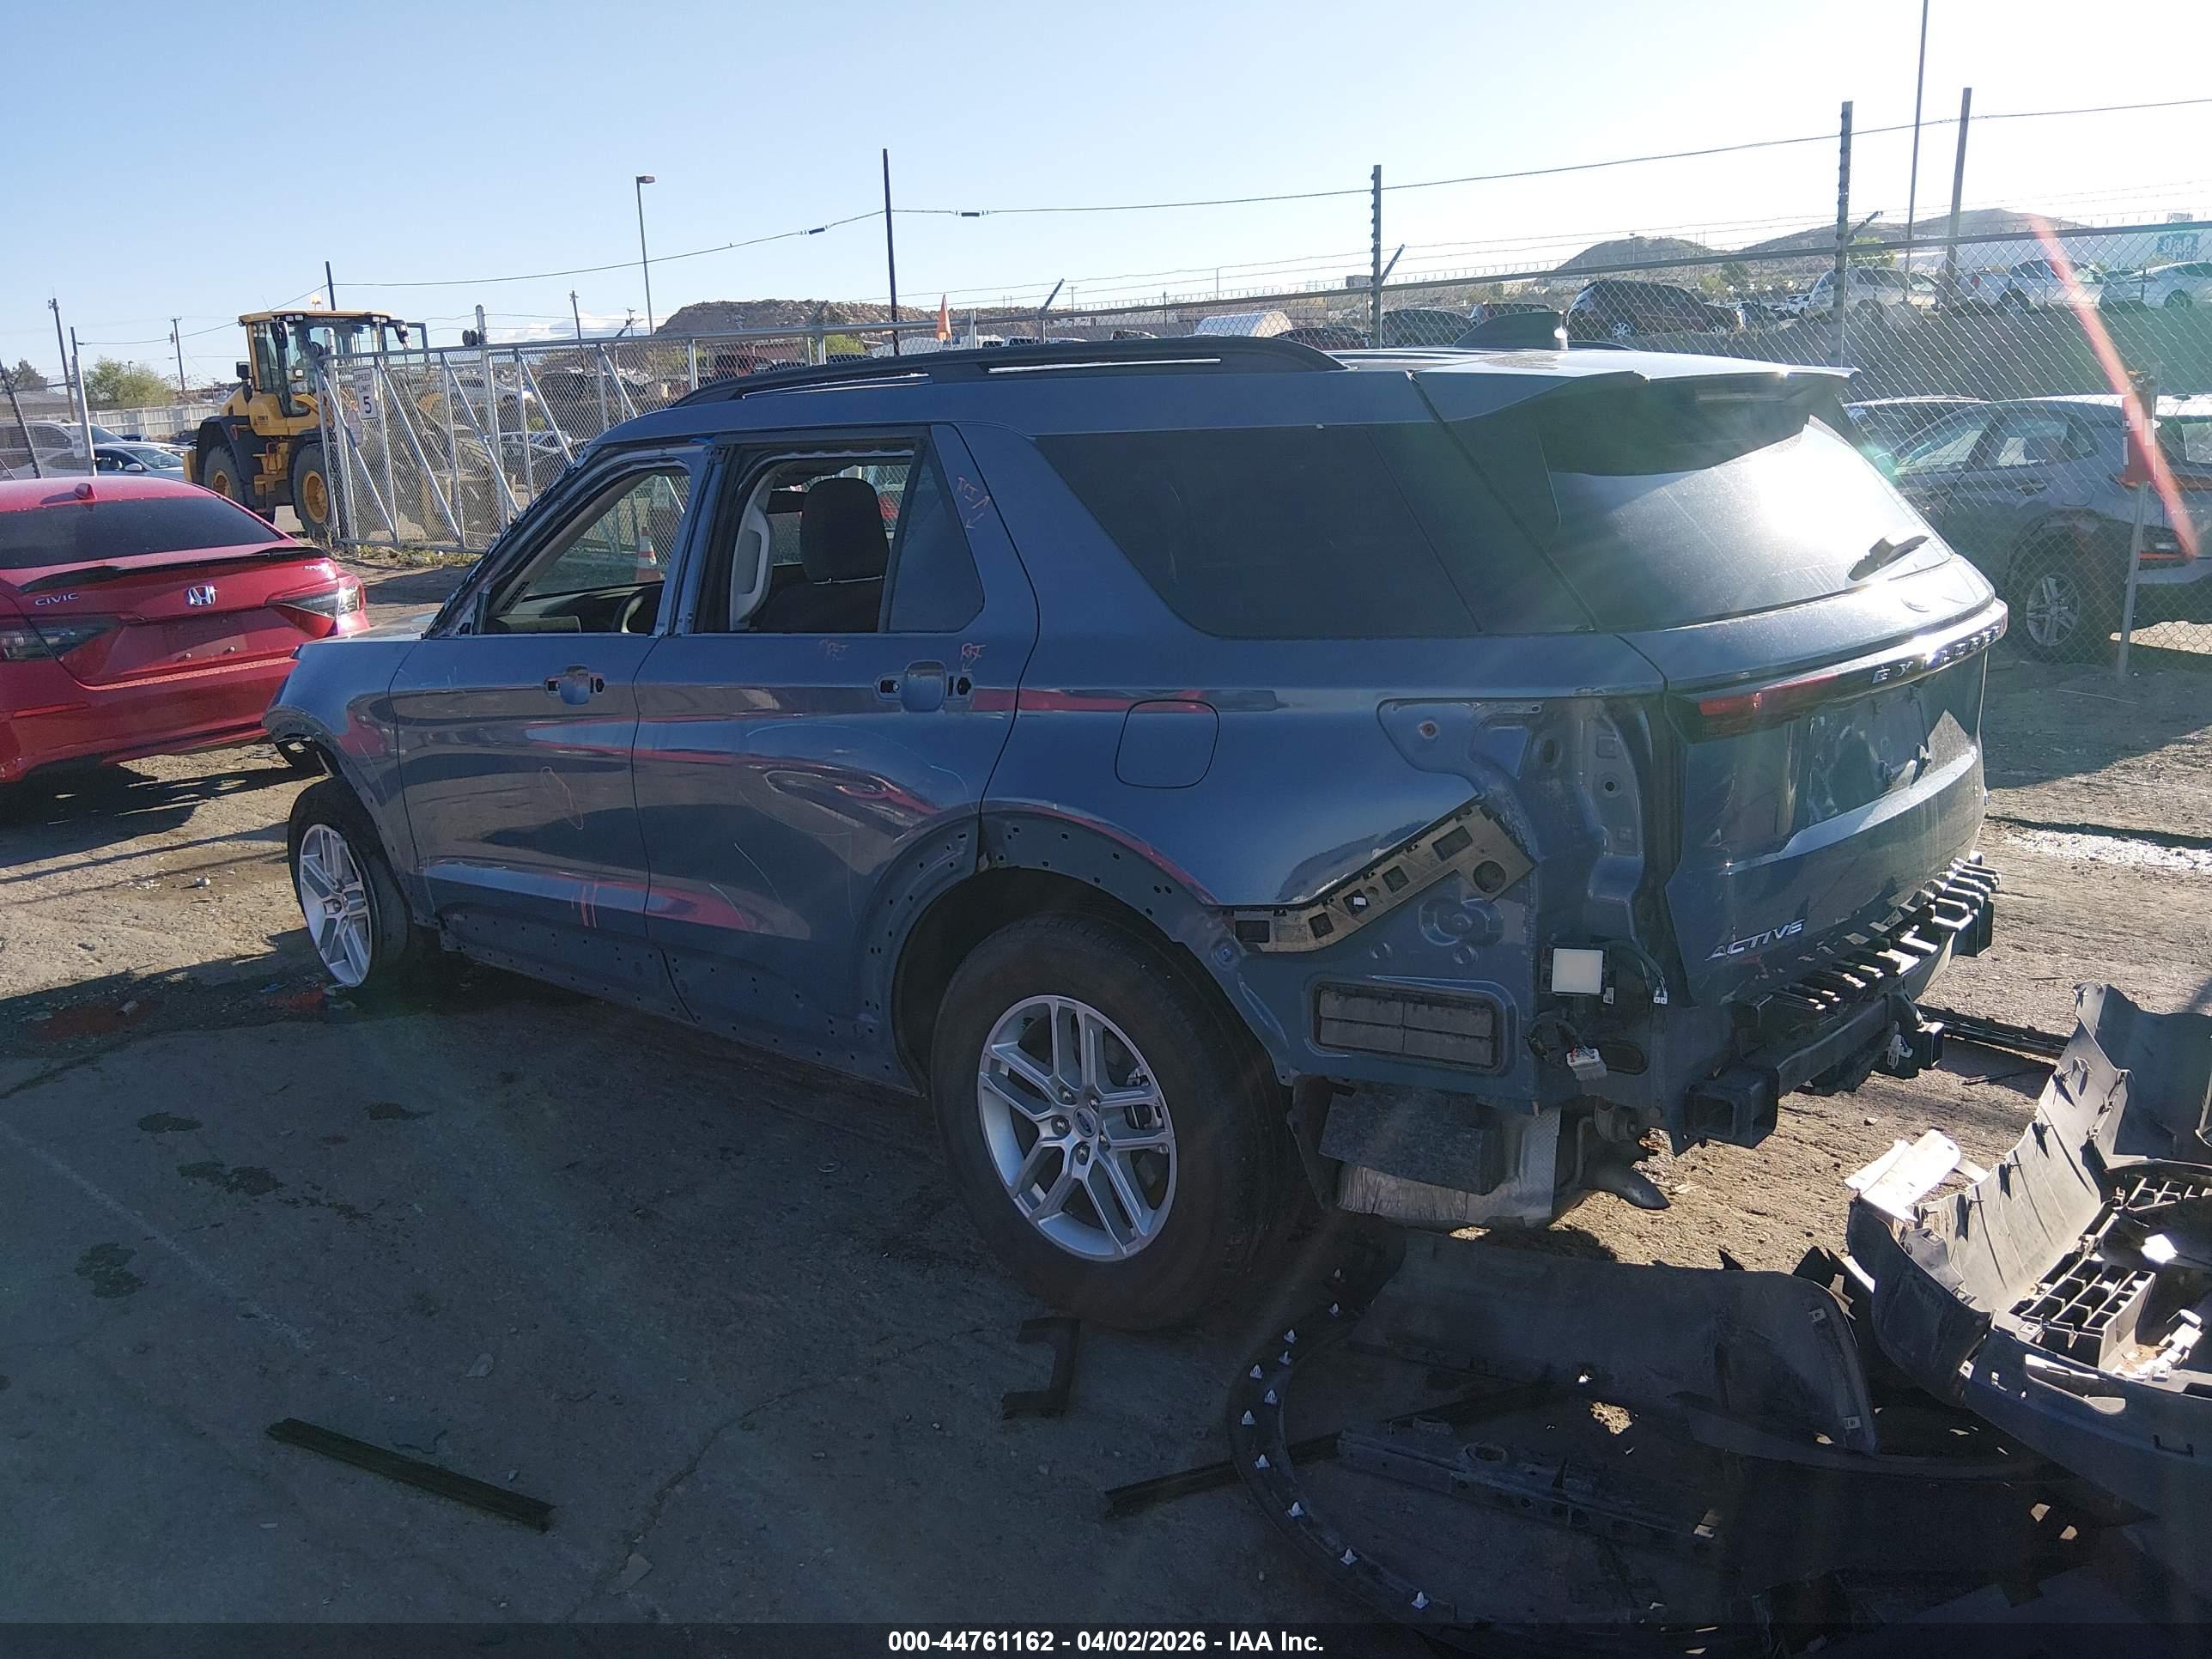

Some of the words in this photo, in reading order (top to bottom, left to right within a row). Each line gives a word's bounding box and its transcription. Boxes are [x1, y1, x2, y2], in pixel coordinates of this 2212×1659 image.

[355, 373, 371, 381] SPEED
[358, 384, 371, 393] LIMIT
[362, 396, 372, 414] 5
[35, 592, 79, 606] CIVIC
[1704, 918, 1806, 962] ACTIVE
